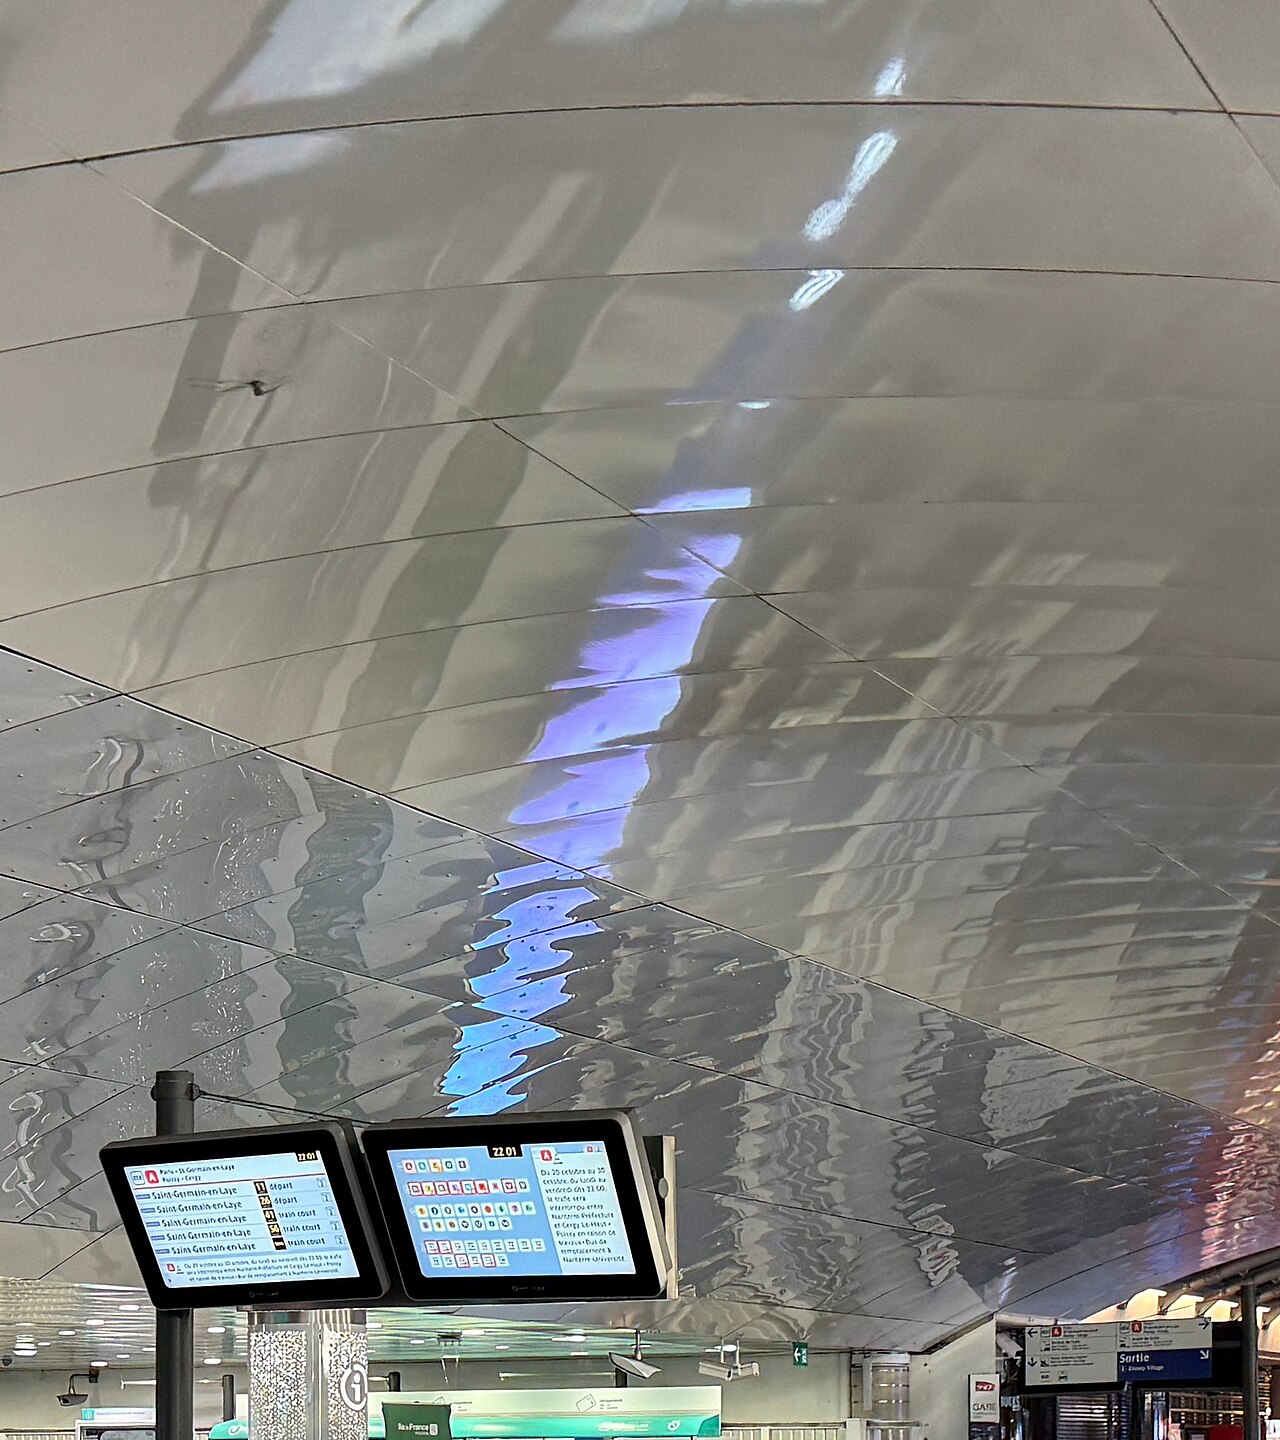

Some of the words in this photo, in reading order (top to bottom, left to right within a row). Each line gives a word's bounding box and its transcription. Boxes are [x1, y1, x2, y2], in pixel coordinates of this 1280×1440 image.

[255, 1182, 265, 1191] 11
[270, 1182, 293, 1190] départ
[274, 1197, 297, 1205] départ
[1119, 1353, 1150, 1363] Sortie
